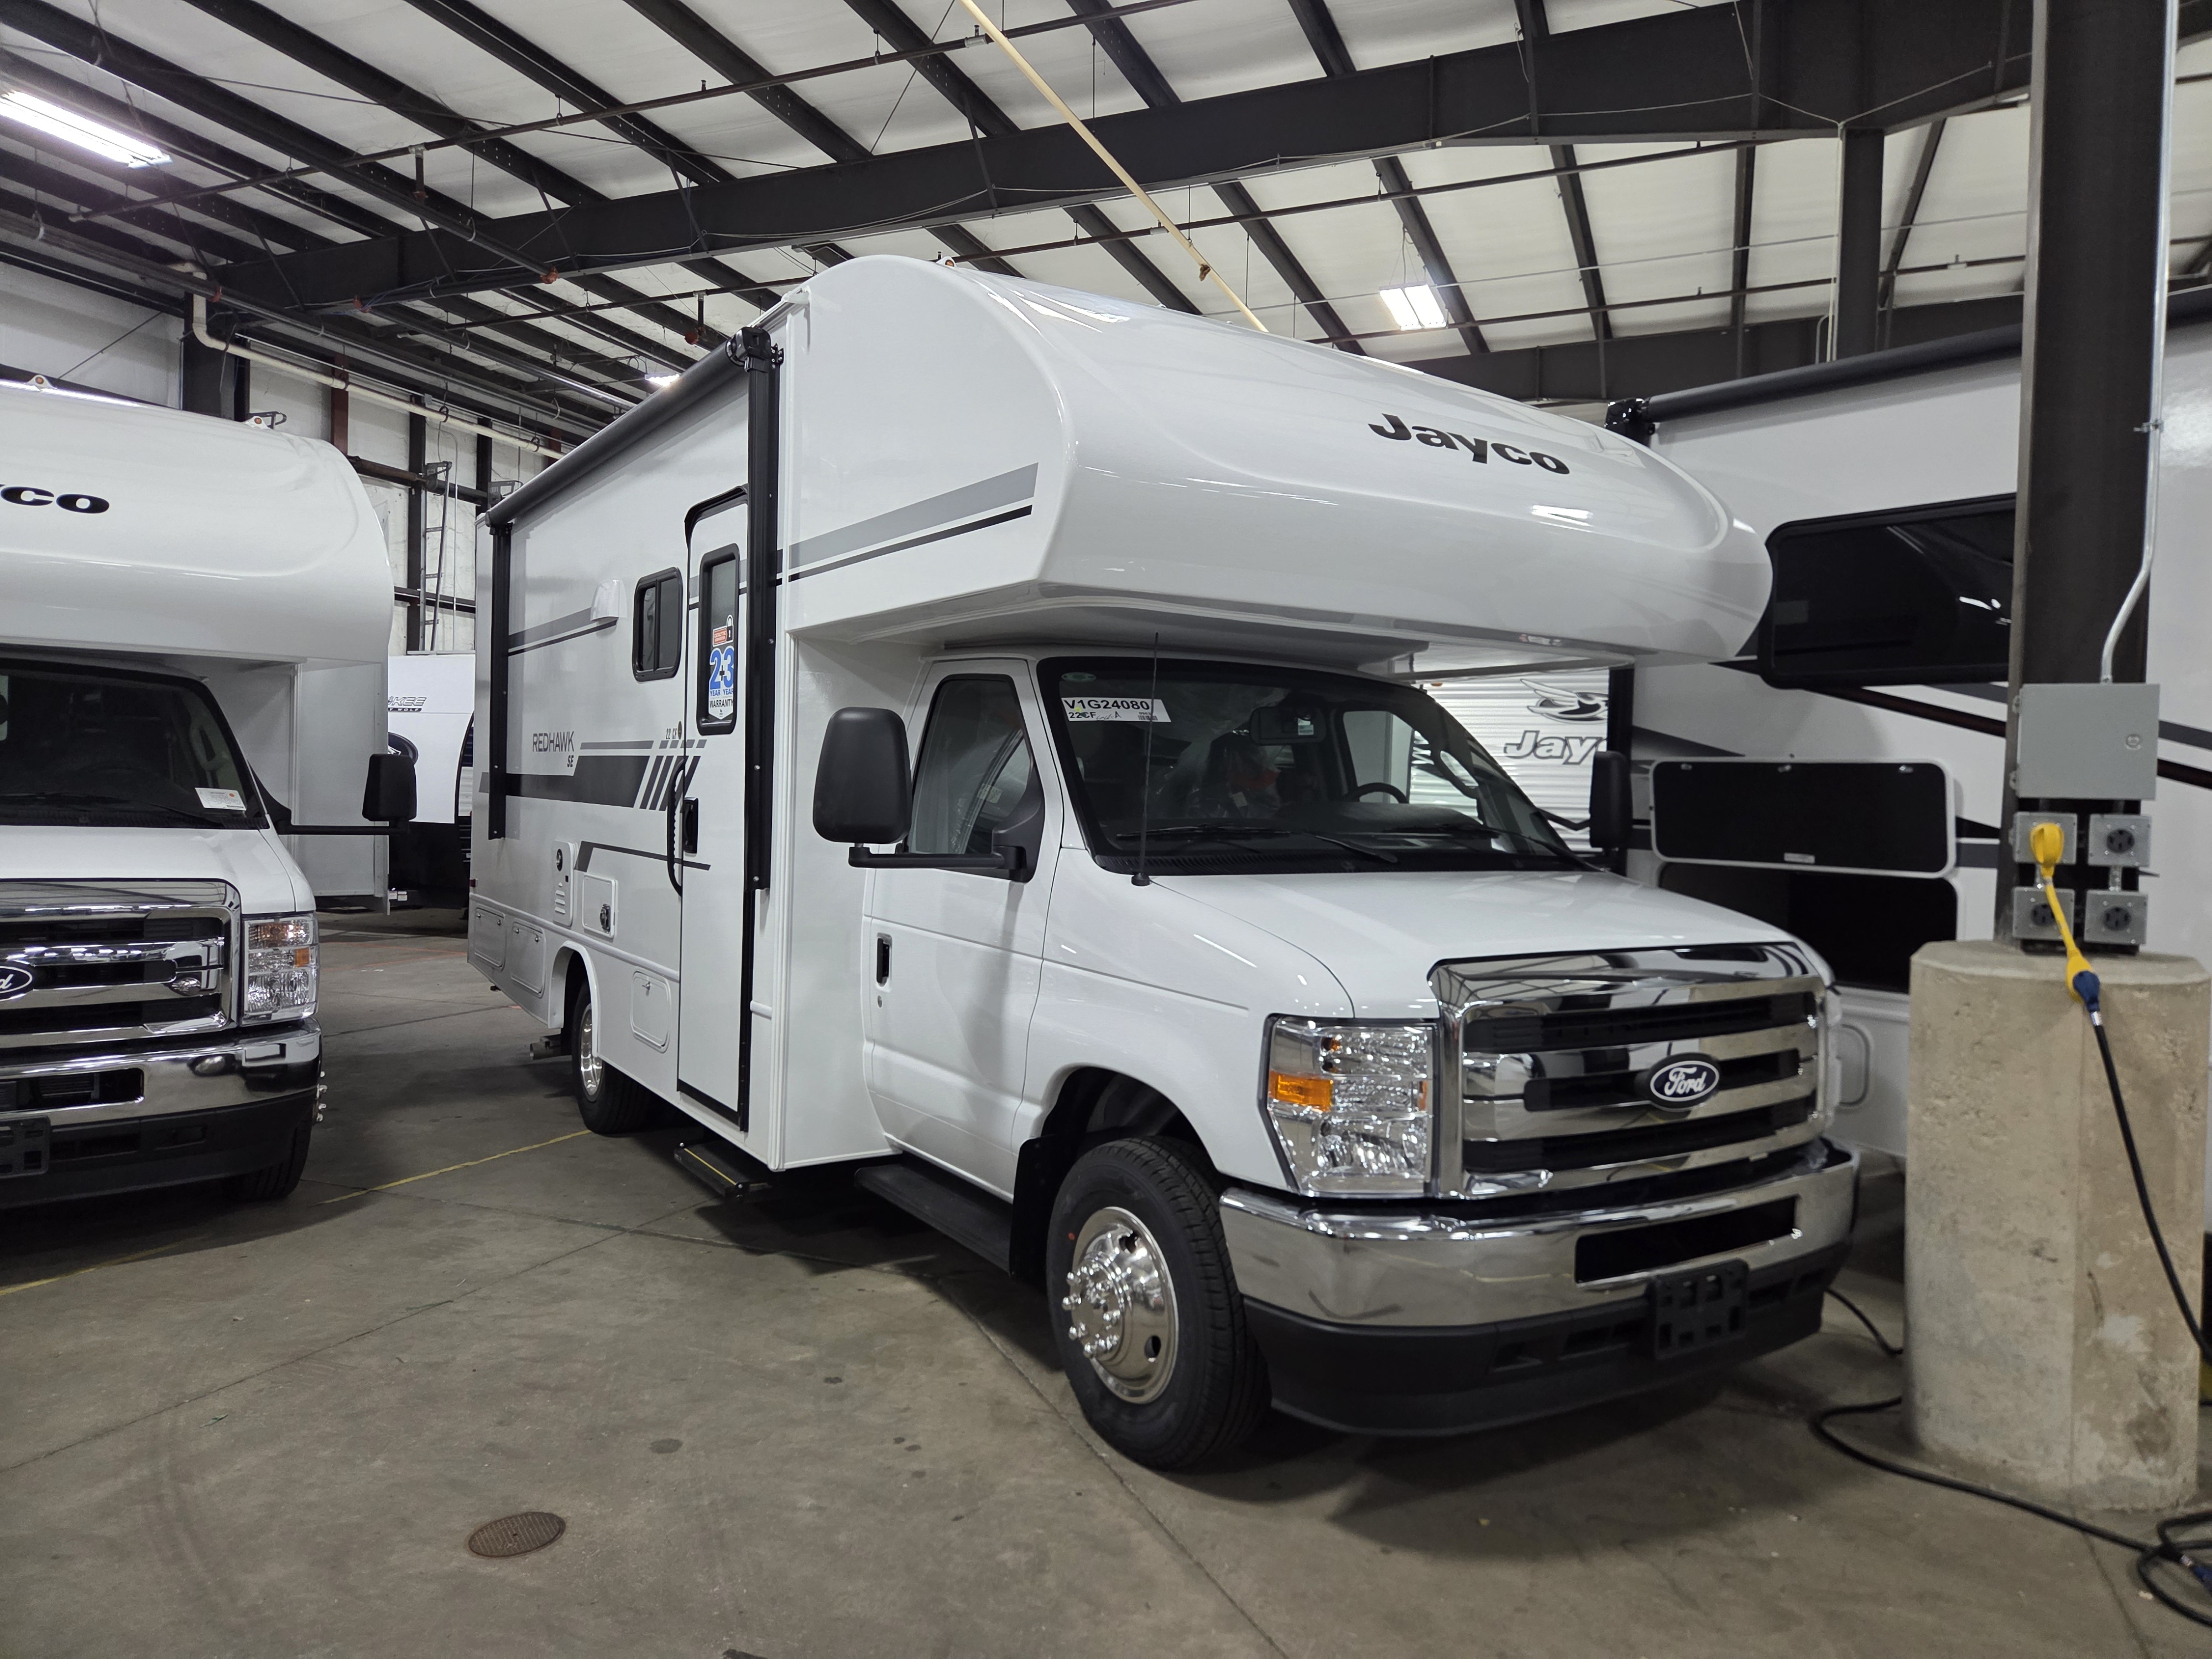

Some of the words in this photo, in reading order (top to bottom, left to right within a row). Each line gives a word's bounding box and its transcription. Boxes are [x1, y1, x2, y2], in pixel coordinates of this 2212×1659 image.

[1368, 413, 1570, 474] Jayco
[0, 484, 109, 514] co
[709, 698, 734, 708] WARRANTY
[1064, 700, 1150, 710] V1G24080
[533, 731, 575, 752] REDHAWK
[567, 755, 575, 768] SE
[1664, 1067, 1707, 1096] Ford
